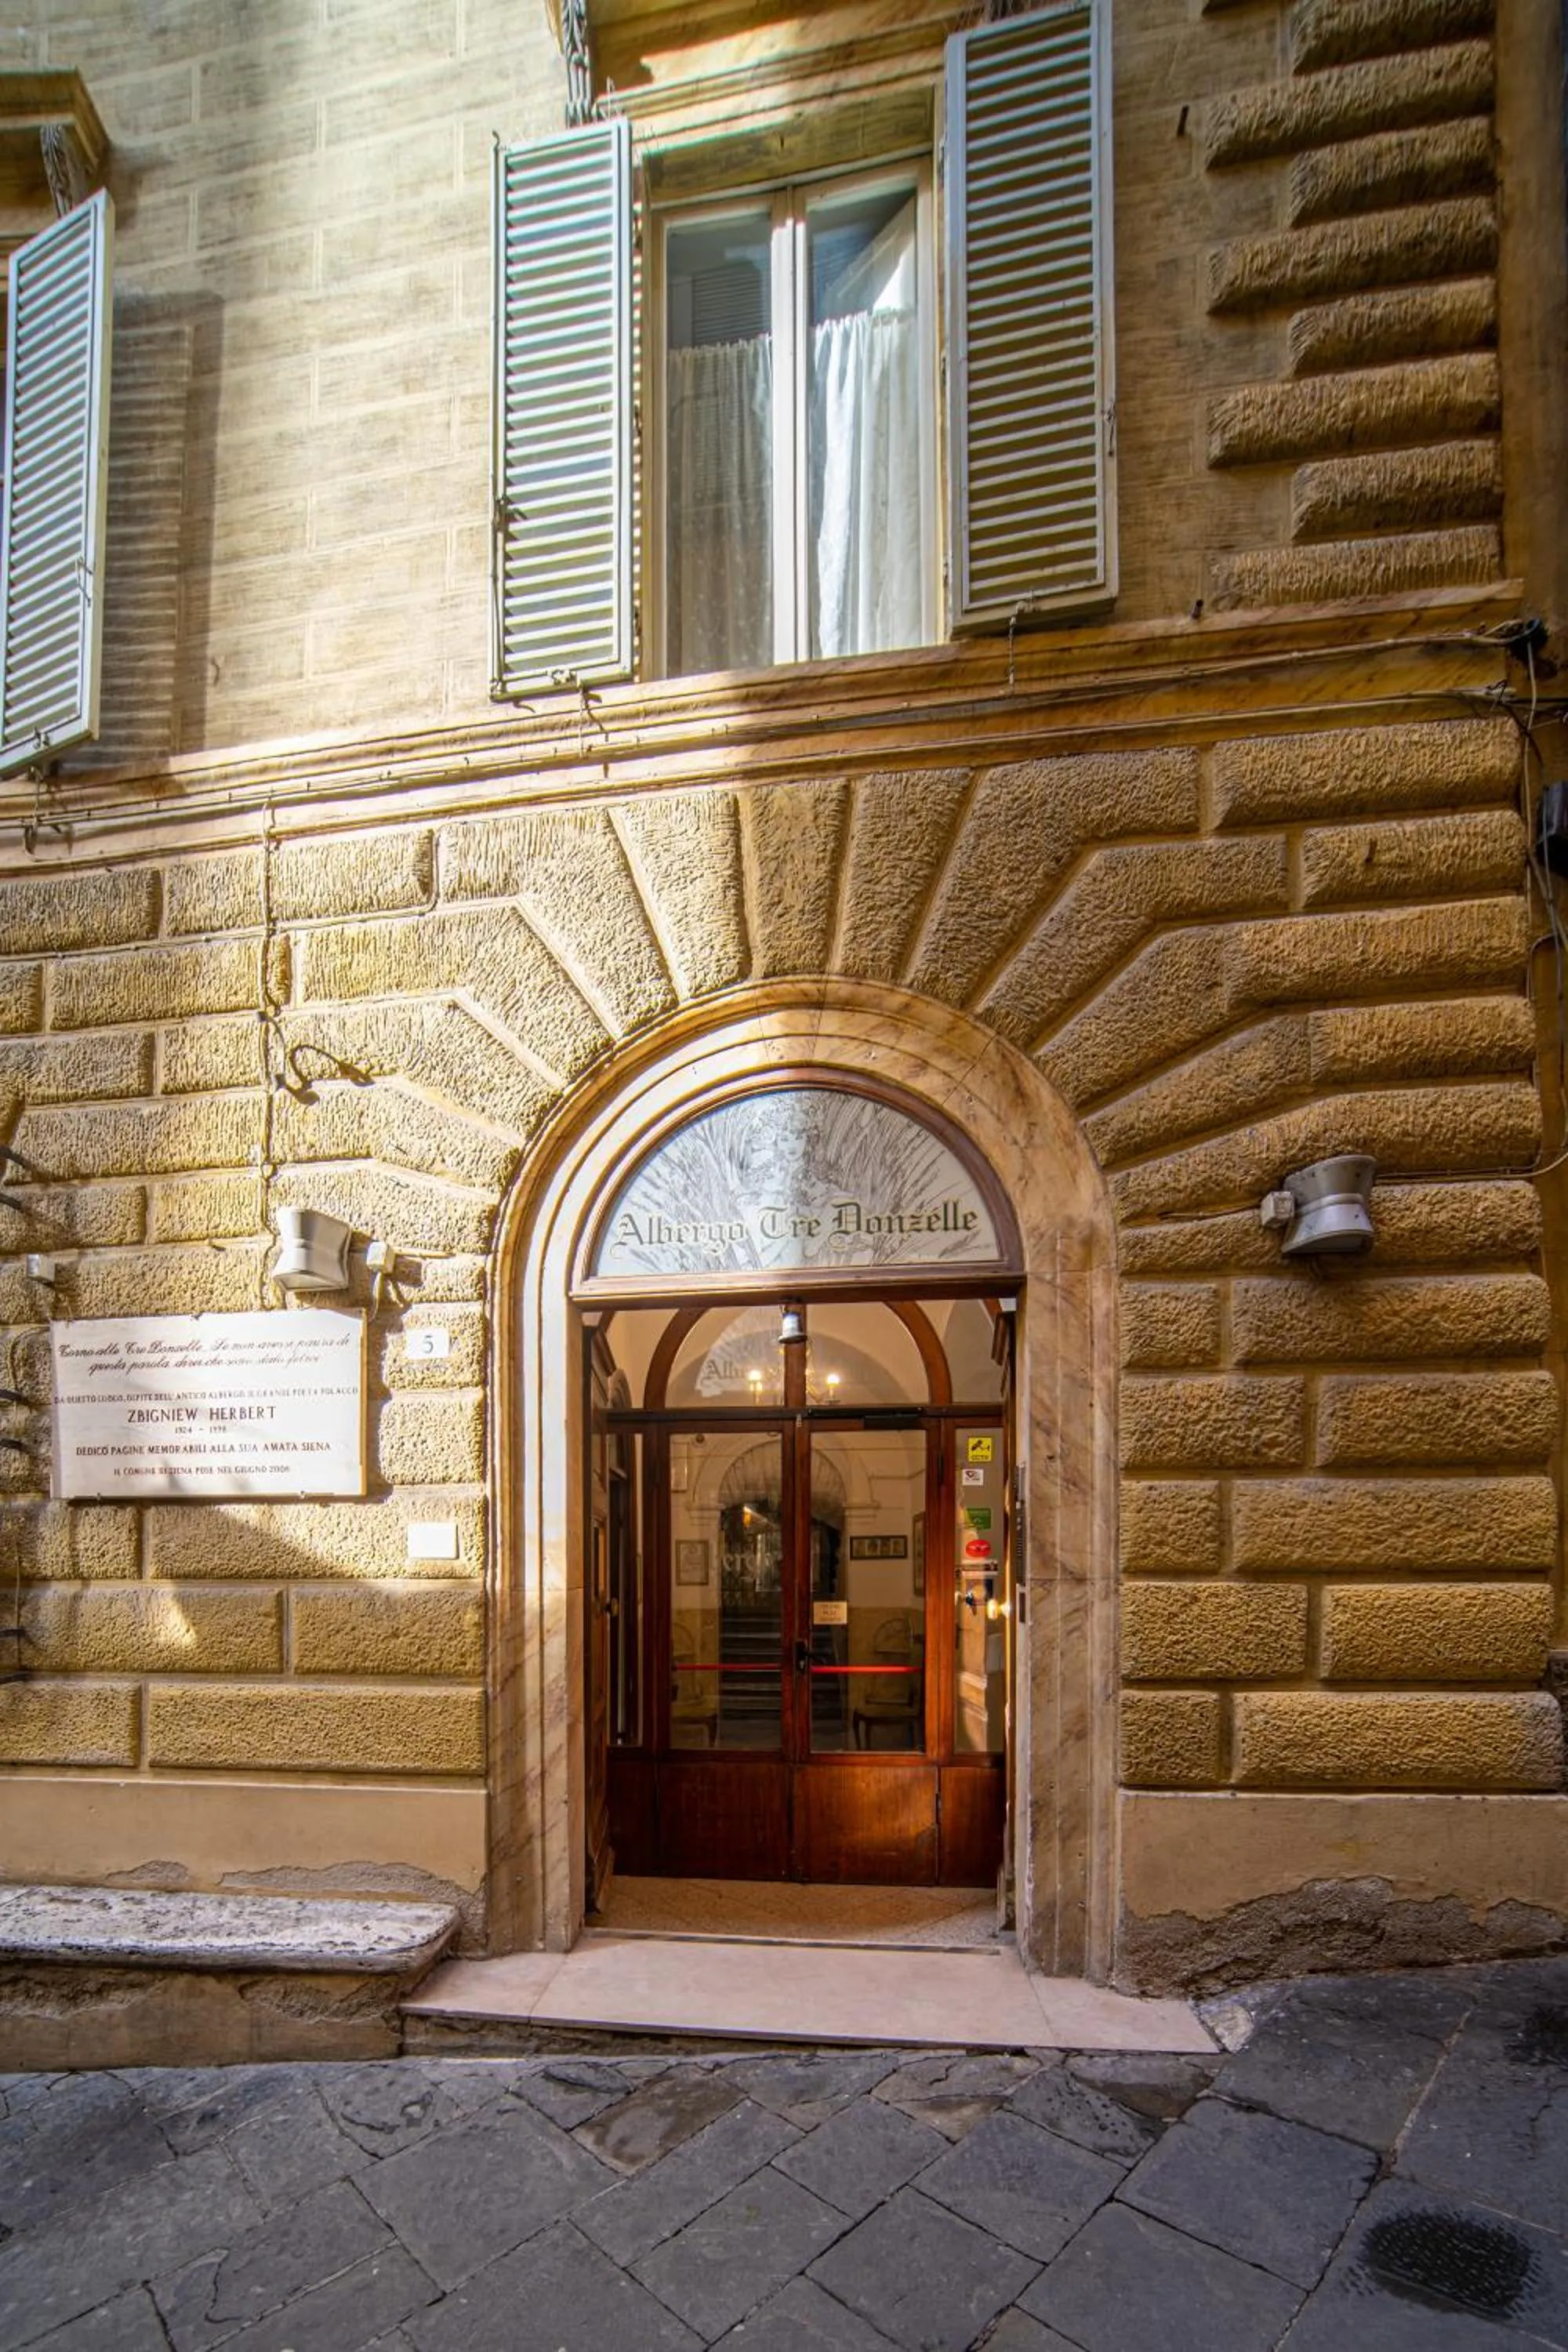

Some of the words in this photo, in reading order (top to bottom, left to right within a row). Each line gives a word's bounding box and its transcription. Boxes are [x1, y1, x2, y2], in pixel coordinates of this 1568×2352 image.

[615, 1213, 746, 1253] Albergo
[759, 1206, 822, 1240] Tre
[830, 1200, 980, 1238] Donzelle
[423, 1335, 434, 1354] 5
[127, 1407, 199, 1423] ZBIGNIEW
[209, 1406, 277, 1421] HERBERT
[111, 1445, 146, 1456] PAGINE
[147, 1443, 206, 1455] MEMORABILI
[209, 1443, 235, 1454] ALLA
[238, 1443, 259, 1453] SUA
[263, 1442, 299, 1452] AMATA
[301, 1441, 332, 1451] SIENA
